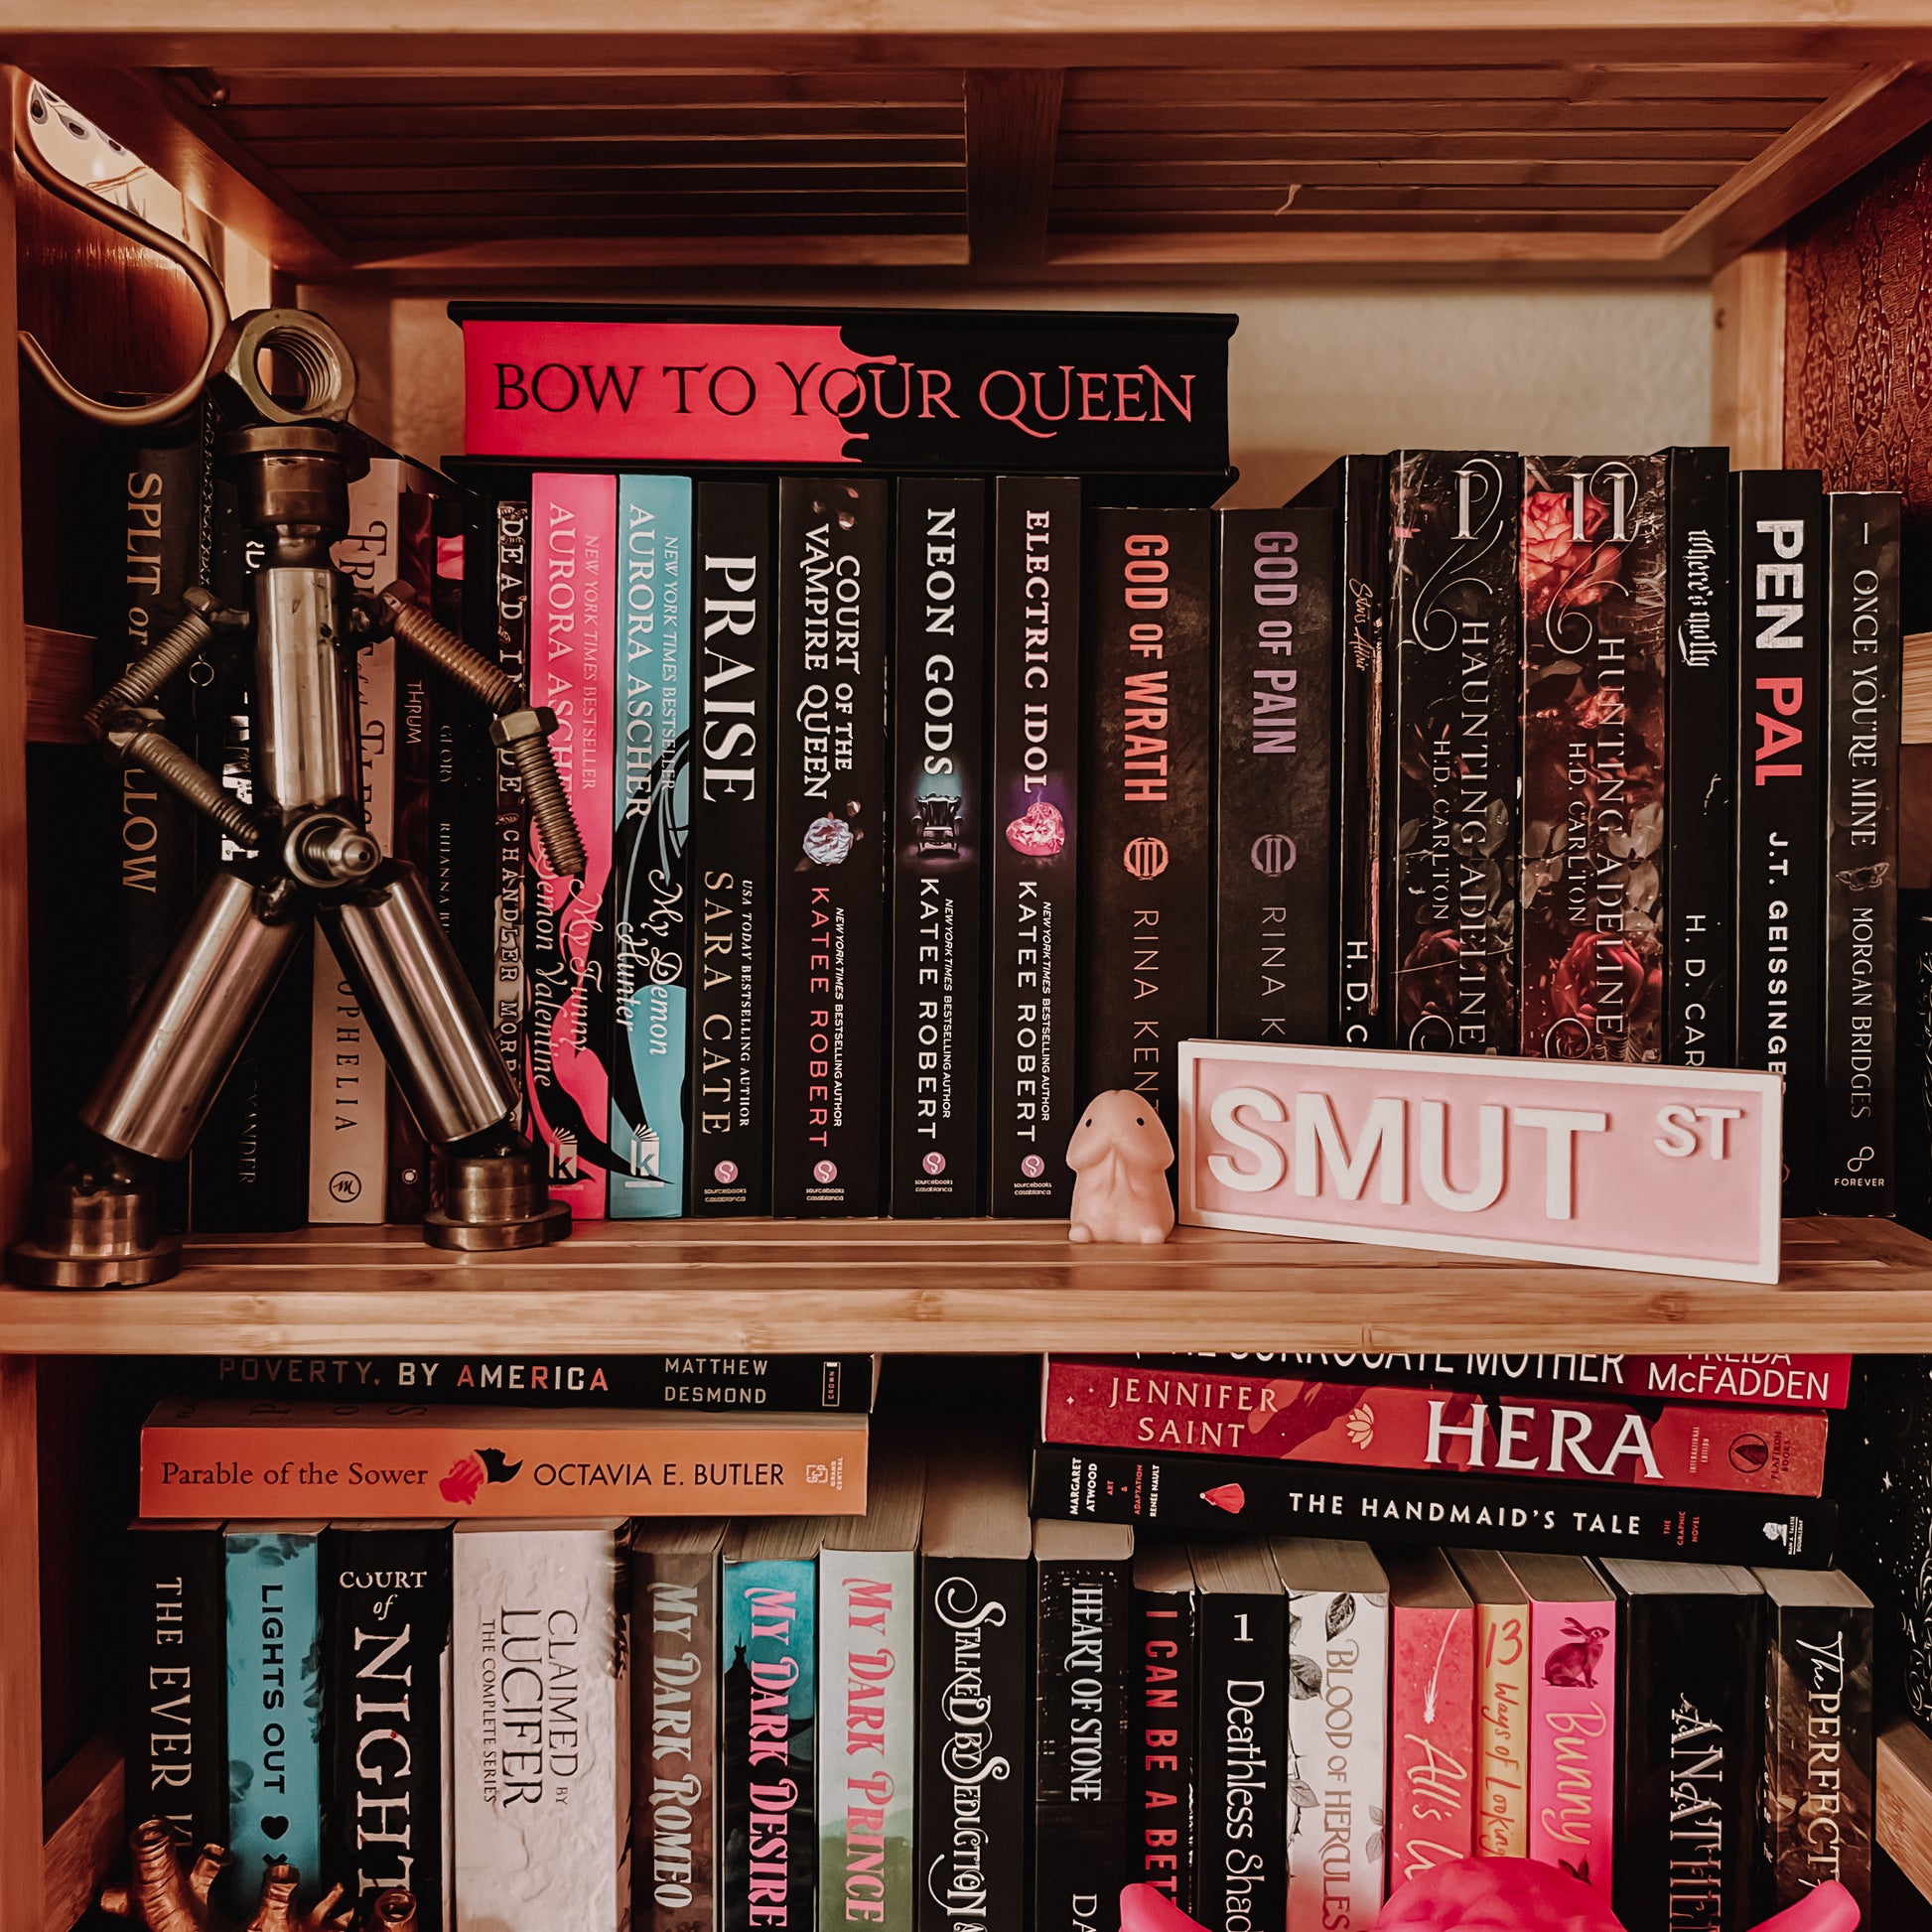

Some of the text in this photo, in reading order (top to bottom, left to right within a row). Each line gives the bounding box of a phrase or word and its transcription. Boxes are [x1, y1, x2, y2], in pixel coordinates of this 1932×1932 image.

[493, 361, 1196, 439] BOW TO YOUR QUEEN
[126, 472, 164, 596] SPLIT
[500, 518, 524, 621] DEAD
[548, 501, 576, 663] AURORA
[403, 679, 425, 745] THRUM
[581, 535, 600, 790] NEW YORK TIMES BESTSELLER
[625, 503, 656, 821] AURORA ASCHER
[660, 535, 679, 791] NEW YORK TIMES BESTSELLER
[702, 554, 758, 803] PRAISE
[796, 522, 835, 800] VAMPIRE QUEEN
[834, 555, 862, 771] COURT OF THE
[923, 507, 956, 776] NEON GODS
[1024, 509, 1050, 794] ELECTRIC IDOL
[1123, 534, 1170, 802] GOD OF WRATH
[1252, 531, 1300, 754] GOD OF PAIN
[1754, 519, 1805, 787] PEN PAL
[1848, 569, 1879, 847] ONCE YOU'RE MINE
[499, 829, 520, 981] CHANDLER
[1432, 797, 1450, 921] CARLTON
[1458, 621, 1490, 1045] HAUNTING ADELINE
[1567, 800, 1587, 923] CARLTON
[1595, 637, 1627, 1035] HUNTING ADELINE
[533, 961, 569, 1088] Valentine
[559, 878, 605, 1052] My Funny
[615, 920, 651, 1033] Hunter
[639, 869, 684, 1056] My Demon
[701, 870, 736, 1136] SARA CATE
[738, 879, 754, 1128] USA TODAY BESTSELLING AUTHOR
[808, 887, 831, 1148] KATEE ROBERT
[916, 878, 940, 1140] KATEE ROBERT
[941, 897, 954, 1119] NEW YORK TIMES BESTSELLING AUTHOR
[1016, 881, 1038, 1143] KATEE ROBERT
[1040, 900, 1052, 1122] NEW YORK TIMES BESTSELLING AUTHOR
[1132, 909, 1160, 1000] RINA
[1260, 906, 1287, 997] RINA
[1684, 914, 1708, 988] H. D.
[1850, 906, 1874, 1119] MORGAN BRIDGES
[1206, 1086, 1742, 1220] SMUT ST
[1834, 1177, 1886, 1187] FOREVER
[398, 1362, 610, 1392] BY AMERICA
[663, 1357, 769, 1376] MATTHEW
[663, 1385, 768, 1405] DESMOND
[1108, 1377, 1280, 1414] JENNIFER
[1138, 1417, 1246, 1449] SAINT
[1423, 1400, 1665, 1480] HERA
[1647, 1361, 1830, 1402] McFADDEN
[161, 1460, 429, 1486] Parable of the Sower
[533, 1462, 785, 1486] OCTAVIA E. BUTLER
[1069, 1456, 1083, 1516] MARGARET
[1086, 1462, 1098, 1513] ATWOOD
[1106, 1479, 1115, 1496] ART
[1134, 1463, 1144, 1516] ADAPTATION
[1152, 1463, 1161, 1491] NAULT
[1289, 1492, 1641, 1536] THE HANDMAID'S TALE
[1663, 1519, 1672, 1535] THE
[1677, 1510, 1687, 1547] GRAPHIC
[1691, 1515, 1701, 1543] NOVEL
[155, 1577, 184, 1646] THE
[339, 1571, 428, 1589] COURT
[372, 1593, 398, 1620] of
[149, 1665, 193, 1790] EVER
[260, 1584, 286, 1795] LIGHTS OUT
[353, 1622, 415, 1897] NIGHT
[481, 1618, 497, 1804] THE COMPLETE SERIES
[500, 1604, 545, 1809] LUCIFER
[547, 1608, 580, 1806] CLAIMED BY
[646, 1582, 702, 1909] MY DARK ROMEO
[744, 1587, 800, 1929] MY DARK DESIRE
[841, 1577, 897, 1924] MY DARK PRINCE
[1063, 1587, 1104, 1803] HEART OF STONE
[1144, 1609, 1178, 1810] I CAN BE A
[1226, 1679, 1268, 1840] Deathless
[1479, 1617, 1524, 1857] 13 Ways Looking
[1795, 1630, 1845, 1882] The PERFECT
[927, 1745, 1011, 1919] SEDUCTION
[1317, 1638, 1360, 1932] BLOOD OF HERCULES
[1403, 1732, 1468, 1823] All's
[1540, 1700, 1607, 1845] Bunny
